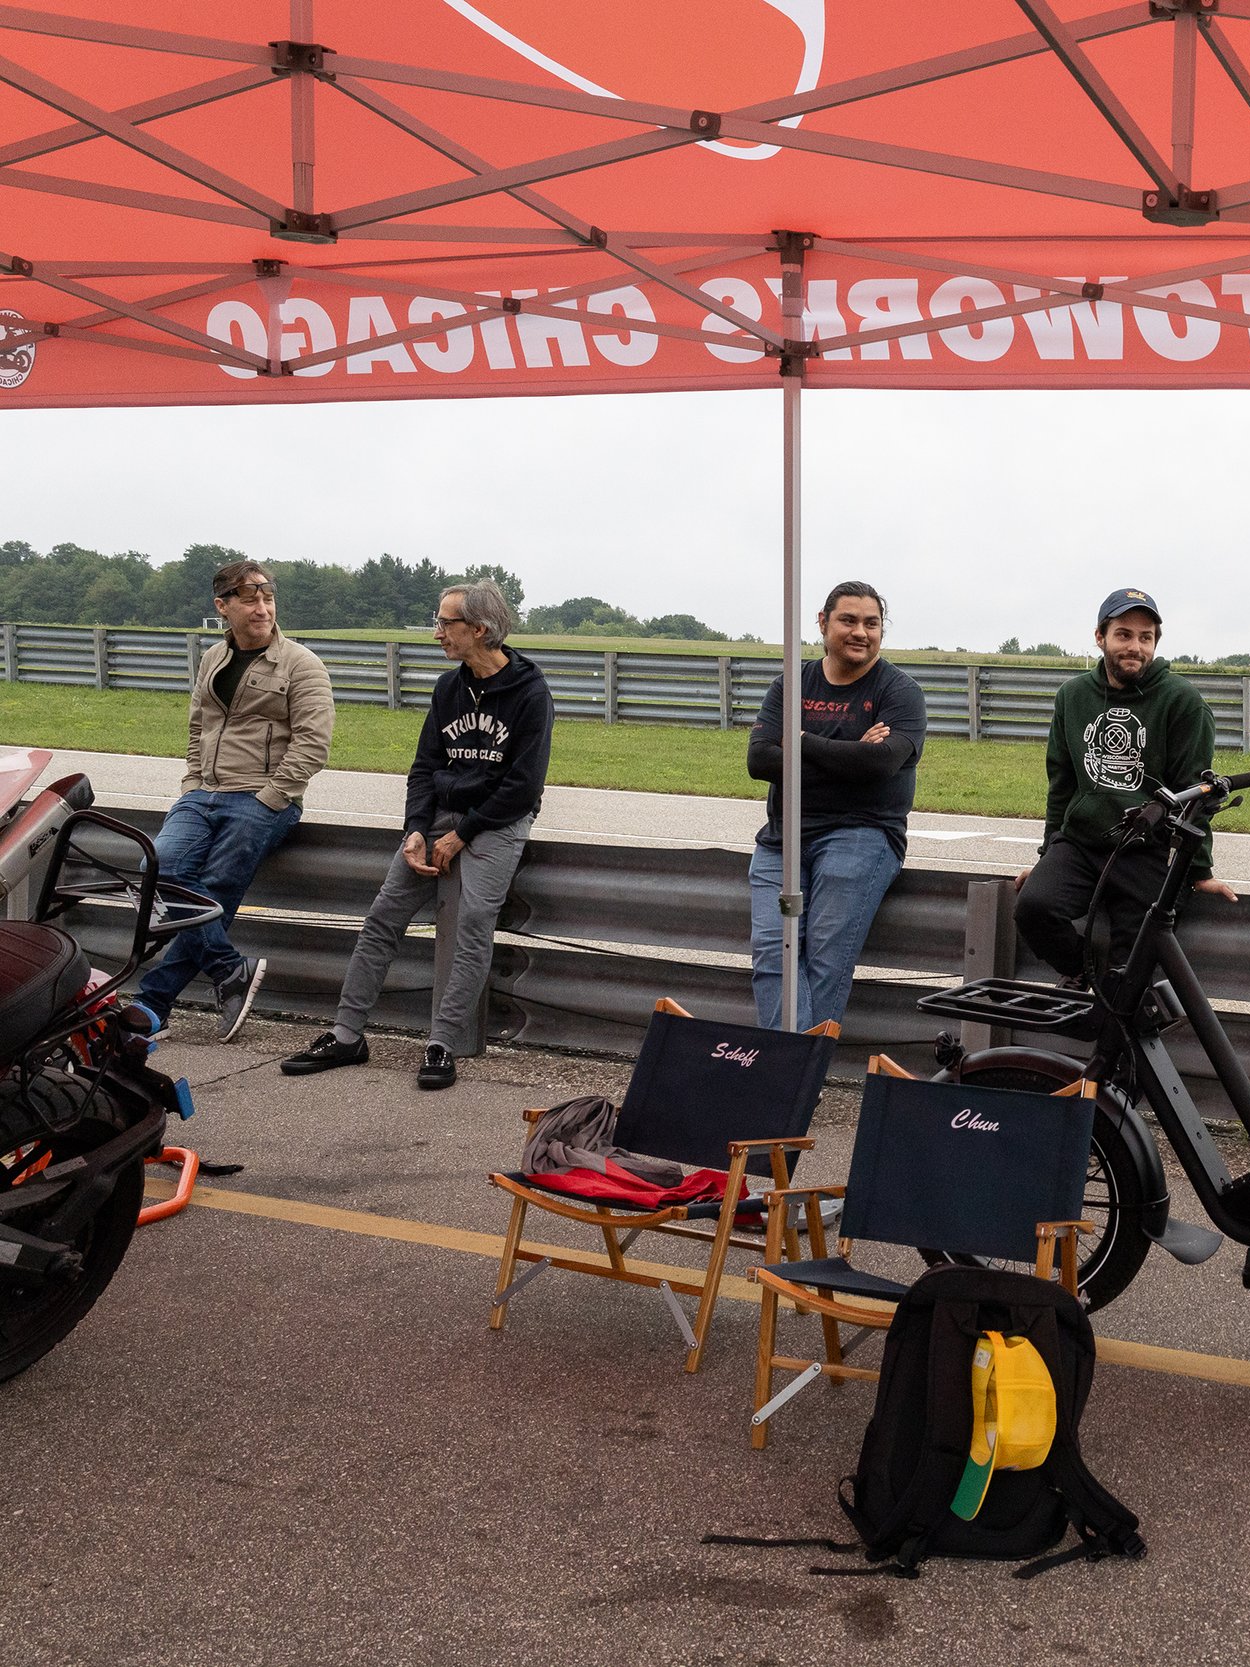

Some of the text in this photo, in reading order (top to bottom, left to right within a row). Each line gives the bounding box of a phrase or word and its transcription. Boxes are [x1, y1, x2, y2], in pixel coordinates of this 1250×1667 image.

[800, 698, 850, 712] UCATI
[441, 712, 509, 746] TRIUMPH
[711, 1042, 760, 1067] Scheff
[951, 1109, 1000, 1131] Chun
